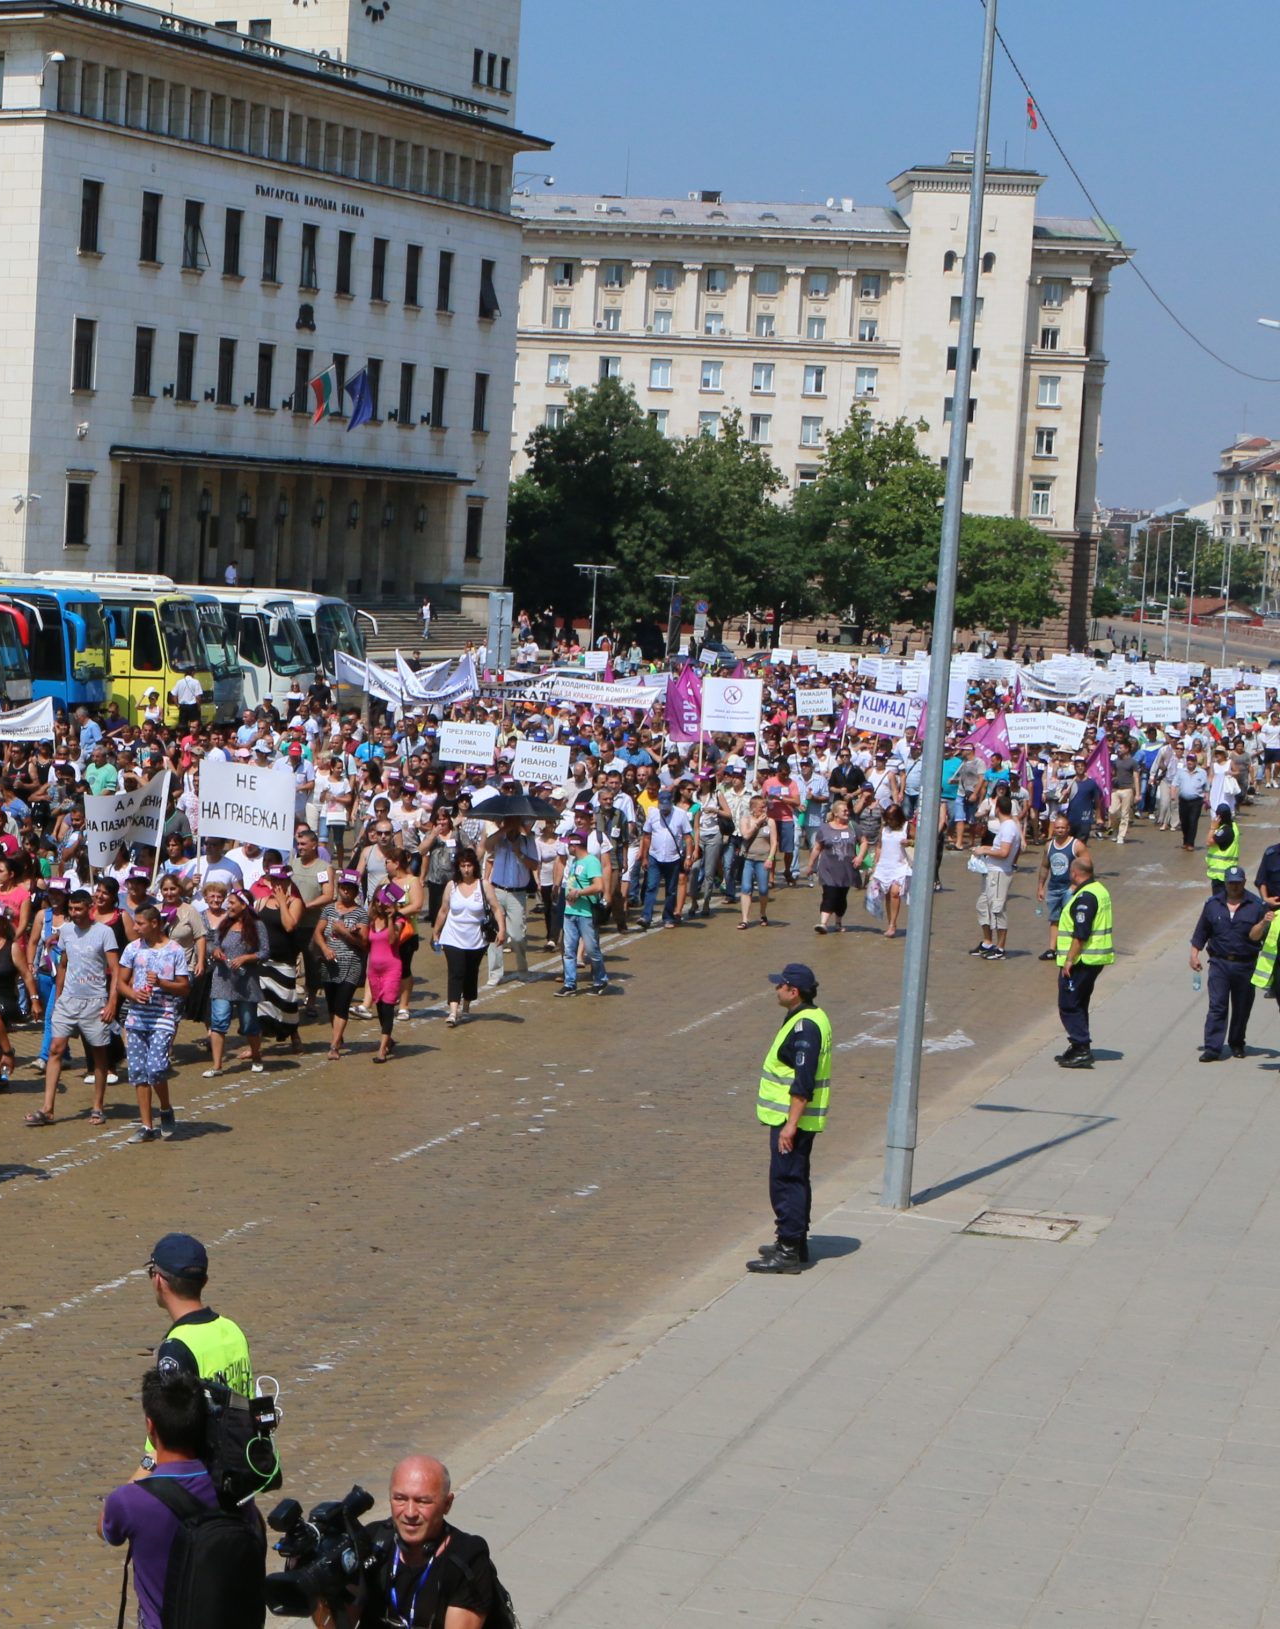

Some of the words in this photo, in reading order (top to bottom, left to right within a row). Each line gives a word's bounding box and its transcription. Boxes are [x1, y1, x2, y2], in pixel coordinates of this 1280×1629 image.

[255, 184, 299, 204] БЪЛГАРСКА
[304, 194, 337, 212] НАРОДНА
[341, 203, 365, 218] БАНКА
[862, 695, 906, 719] КЦМ-АД
[464, 730, 491, 738] ЛЯТОТО
[531, 744, 556, 755] ИВАН
[520, 757, 558, 768] ИВАНОВ
[236, 772, 258, 791] НЕ
[518, 770, 562, 782] ОСТАВКА!
[201, 801, 221, 820] НА
[86, 819, 99, 832] НА
[99, 841, 107, 853] В
